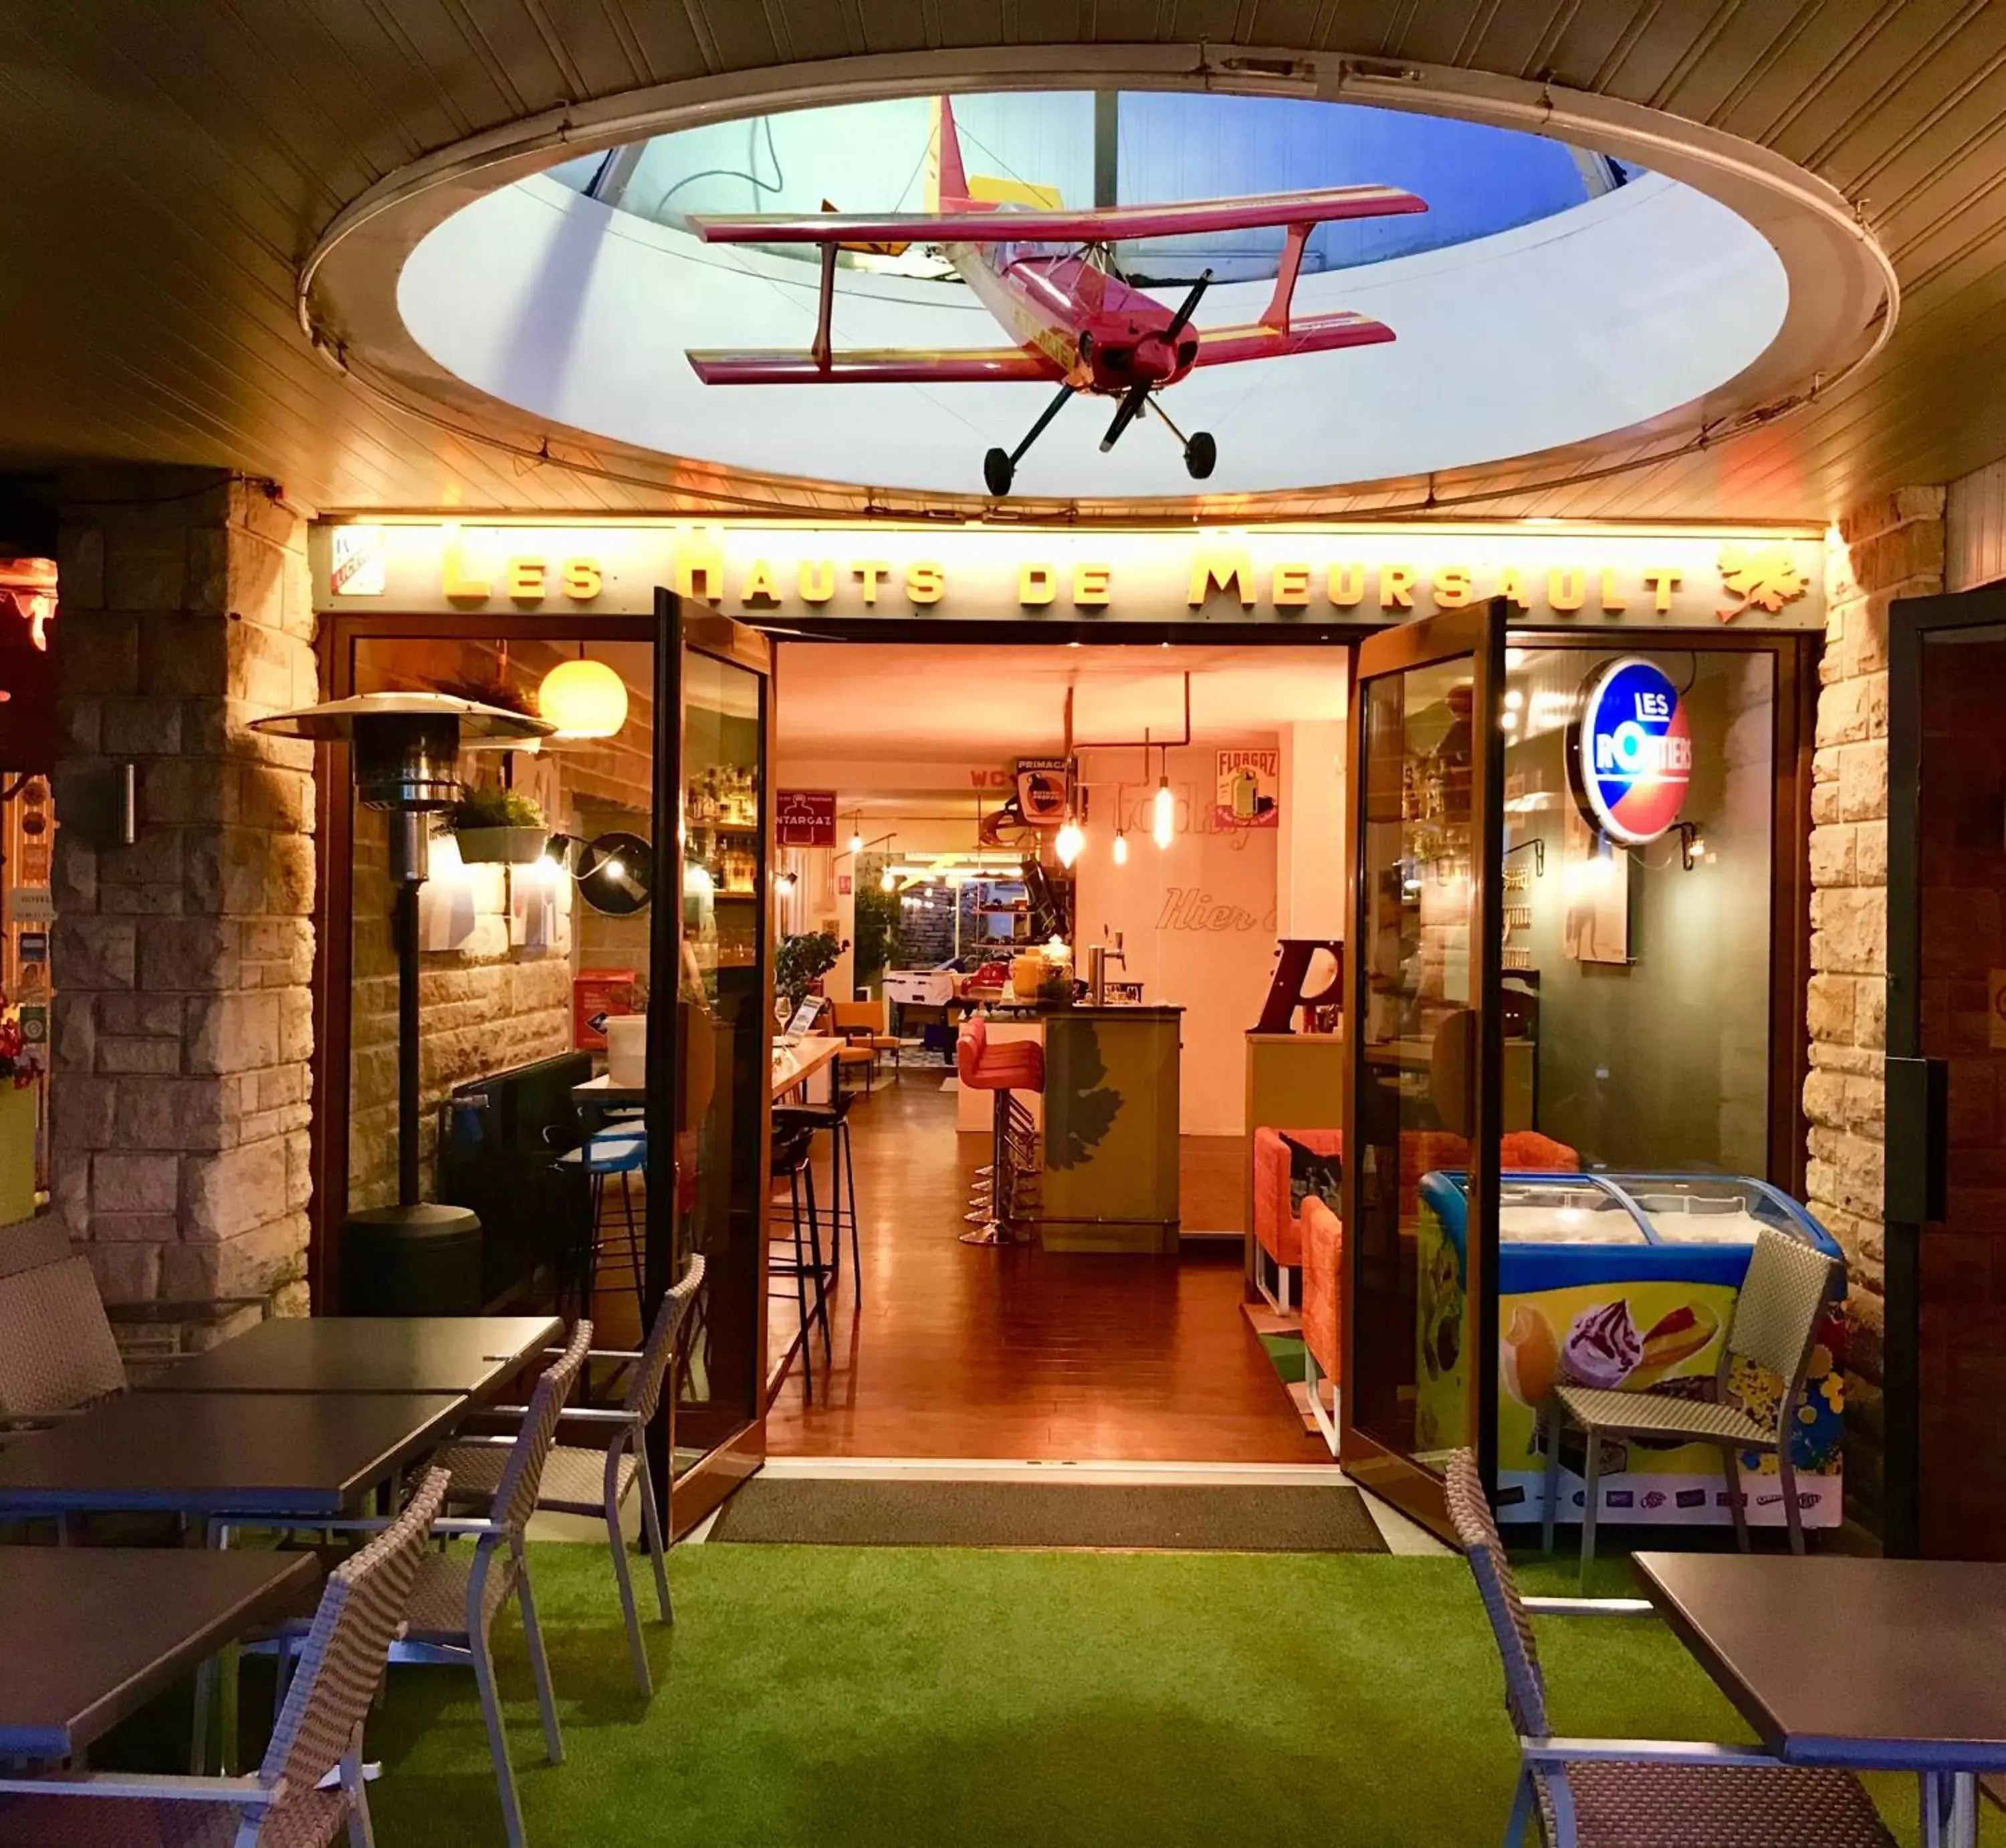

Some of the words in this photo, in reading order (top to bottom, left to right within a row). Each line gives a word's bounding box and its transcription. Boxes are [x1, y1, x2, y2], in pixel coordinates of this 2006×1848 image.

[443, 530, 602, 599] LES
[1019, 562, 1110, 605] DE
[1187, 532, 1683, 610] MEURSAULT
[1634, 692, 1670, 722] LES
[1596, 721, 1692, 771] ROTIERS
[971, 770, 1006, 787] WC
[1018, 760, 1073, 770] PRIMAG
